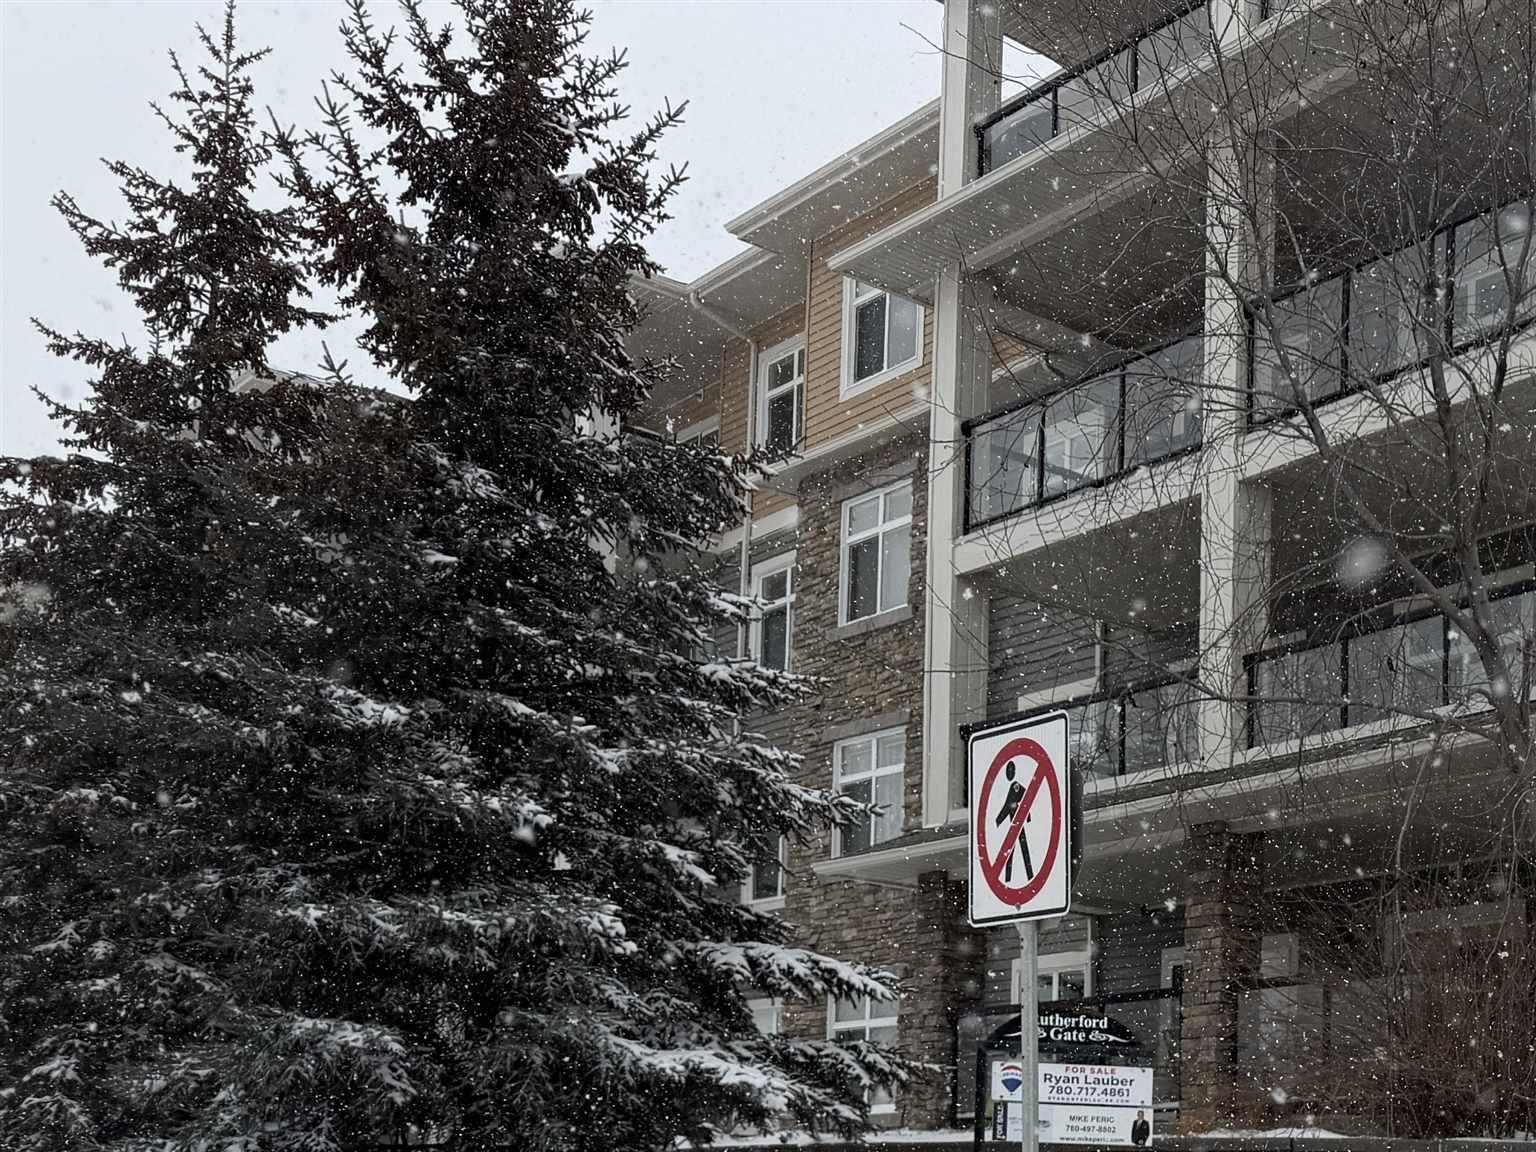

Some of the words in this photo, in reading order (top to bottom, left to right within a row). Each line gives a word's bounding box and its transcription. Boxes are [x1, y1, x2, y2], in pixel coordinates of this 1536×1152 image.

[1037, 1013, 1108, 1029] utherford
[1050, 1027, 1086, 1041] Gate
[1065, 1066, 1086, 1074] FOR
[1090, 1067, 1117, 1075] SALE
[1043, 1073, 1080, 1088] Ryan
[1084, 1074, 1135, 1087] Lauber
[1048, 1085, 1130, 1097] 780.717.4861
[1069, 1115, 1088, 1123] MIKE
[1091, 1115, 1115, 1124] PERIC
